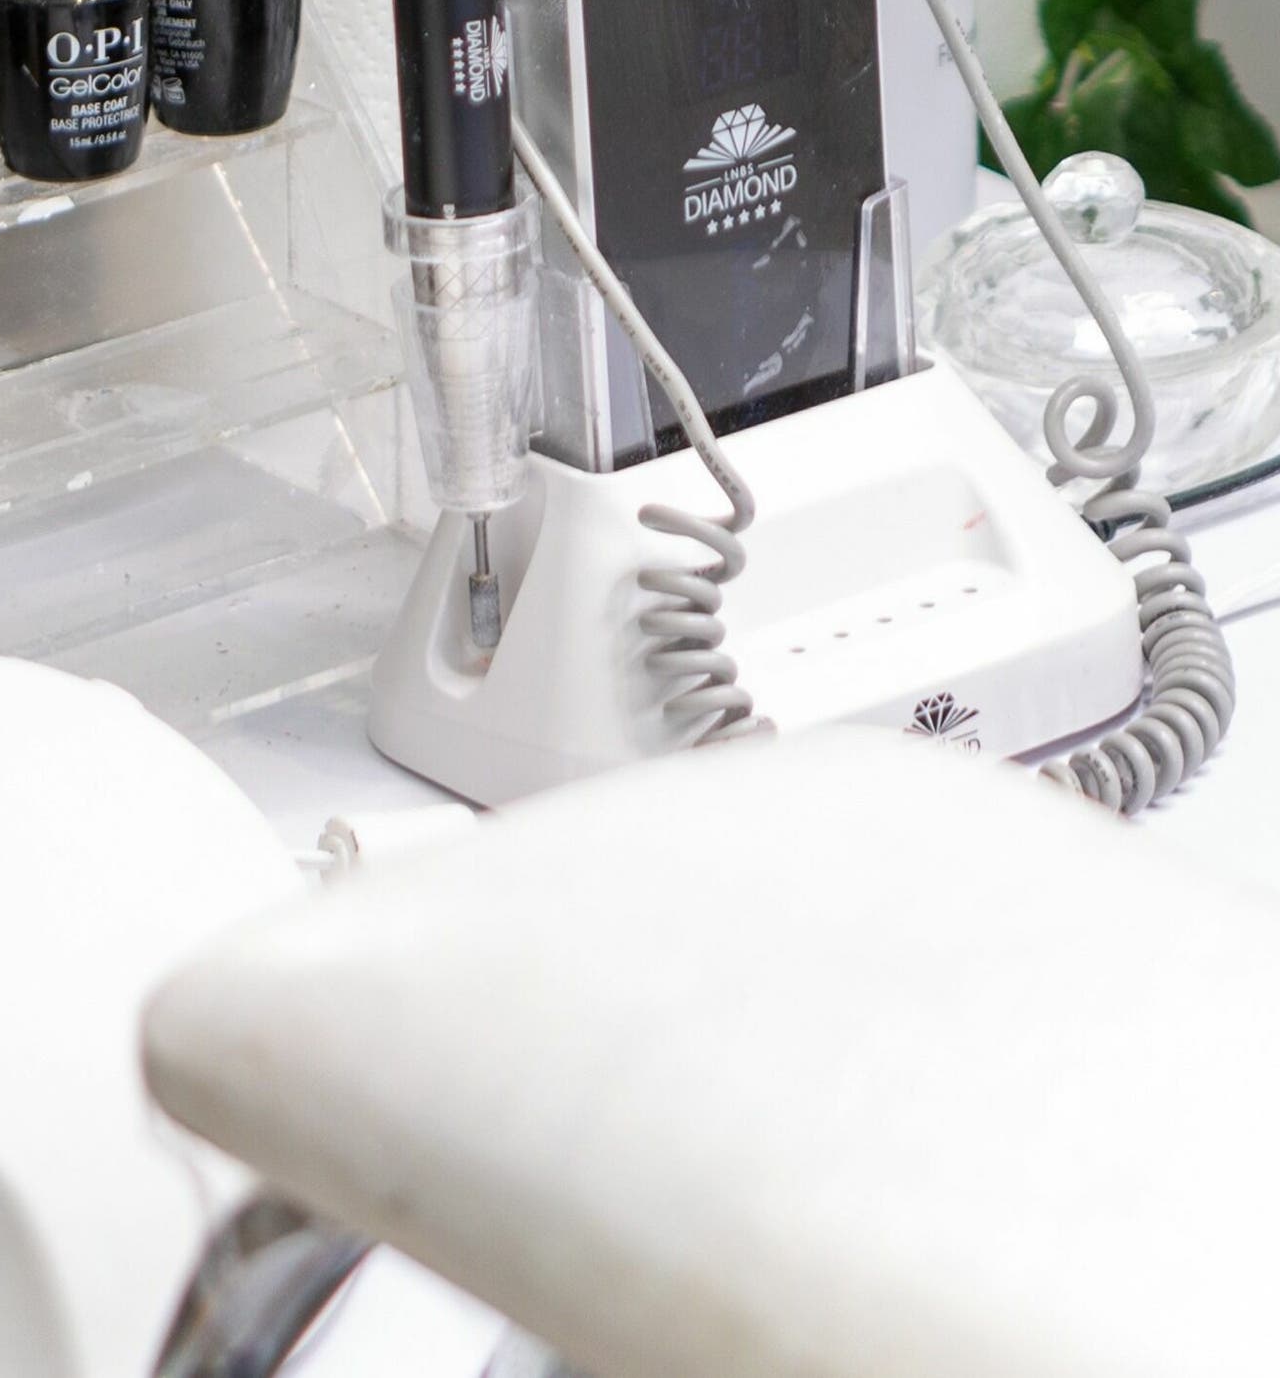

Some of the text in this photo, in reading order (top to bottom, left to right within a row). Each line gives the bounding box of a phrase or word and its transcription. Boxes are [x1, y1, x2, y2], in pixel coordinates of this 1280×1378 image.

[169, 0, 192, 9] ONLY
[466, 20, 486, 102] DIAMOND
[50, 65, 142, 97] GelColor
[51, 103, 141, 131] BASE PROTECTRICE
[71, 95, 128, 117] BASE COAT
[723, 162, 754, 183] LNBS
[684, 164, 798, 223] DIAMOND
